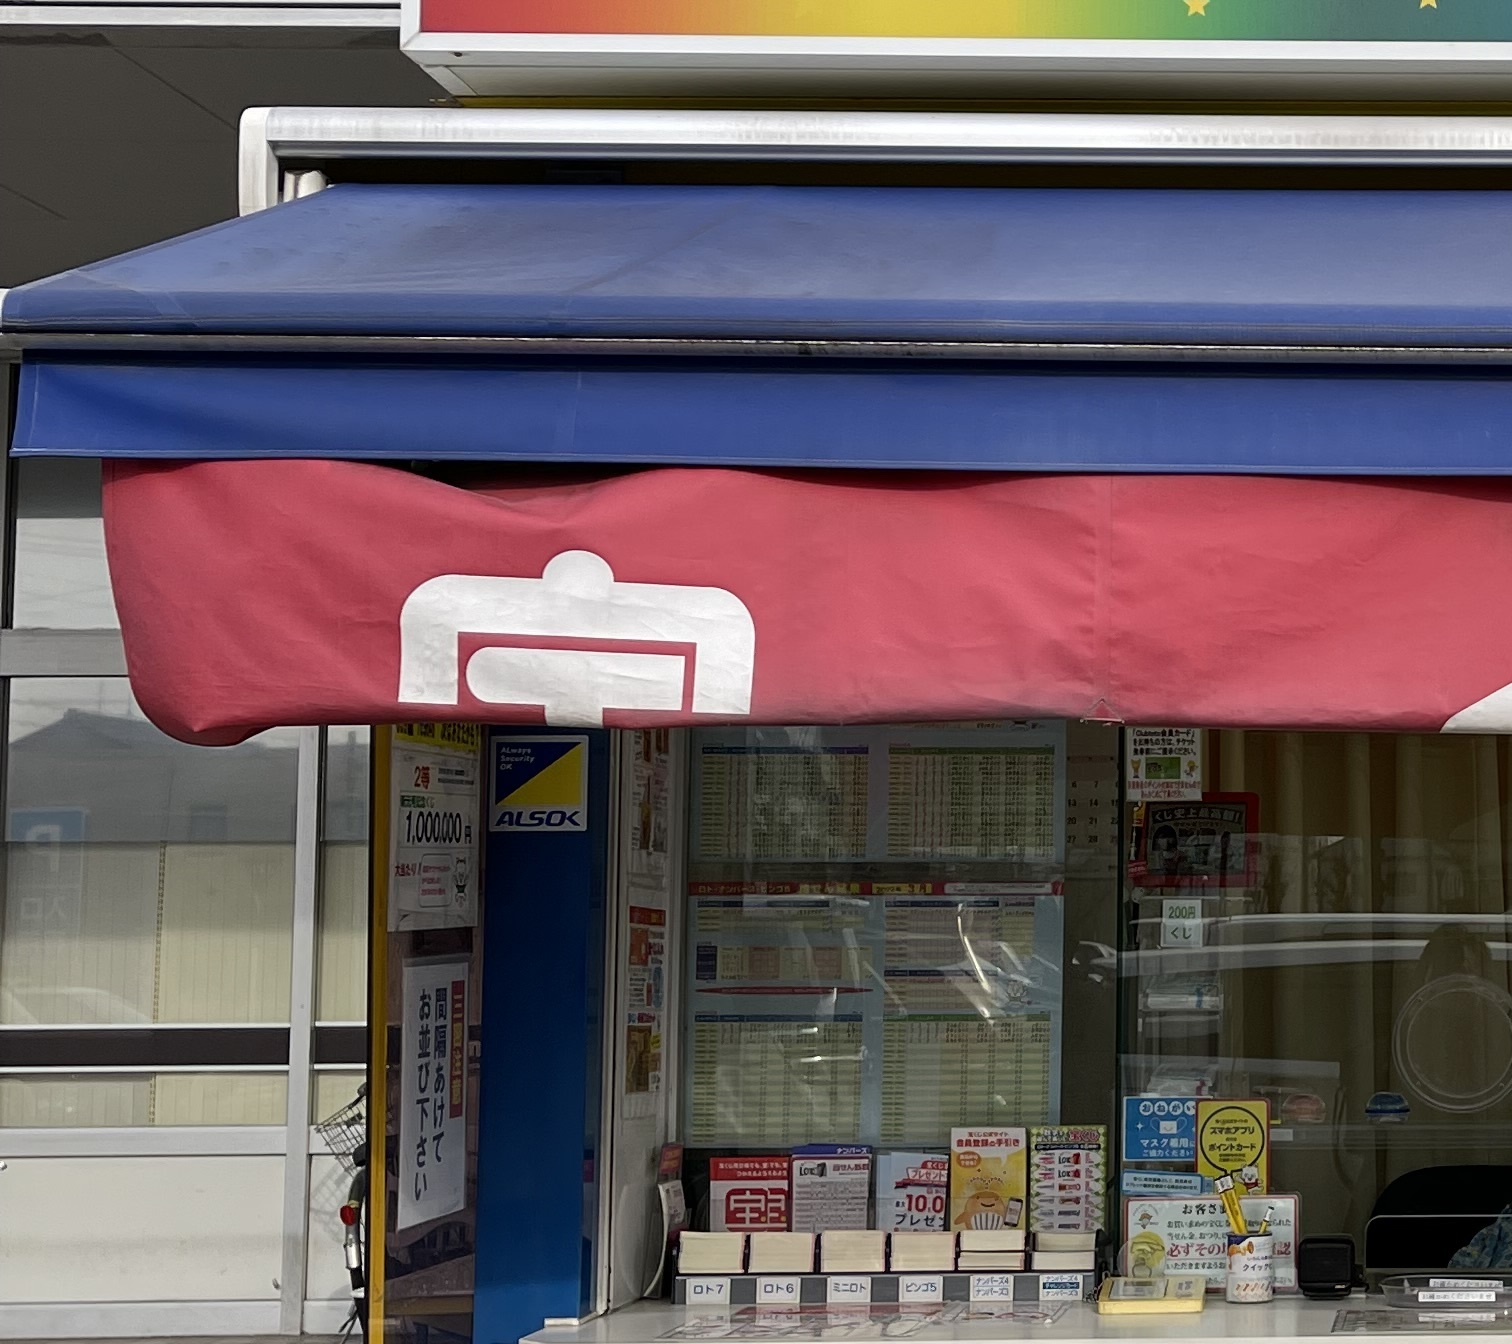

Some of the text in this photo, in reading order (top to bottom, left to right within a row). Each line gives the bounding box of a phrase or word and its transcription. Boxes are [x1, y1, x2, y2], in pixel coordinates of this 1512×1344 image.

[495, 810, 581, 826] ALSOK
[1168, 906, 1196, 919] 200円
[1170, 927, 1192, 939] くじ
[433, 987, 447, 1163] 間隔あけて
[415, 989, 431, 1200] お並び下さい
[1210, 1127, 1254, 1135] スマホアプリ
[1209, 1143, 1256, 1152] ポイントカード
[693, 1284, 723, 1295] ロト7
[764, 1283, 794, 1294] ロト6
[833, 1282, 867, 1294] ミニロト
[906, 1282, 937, 1292] ビンゴ5
